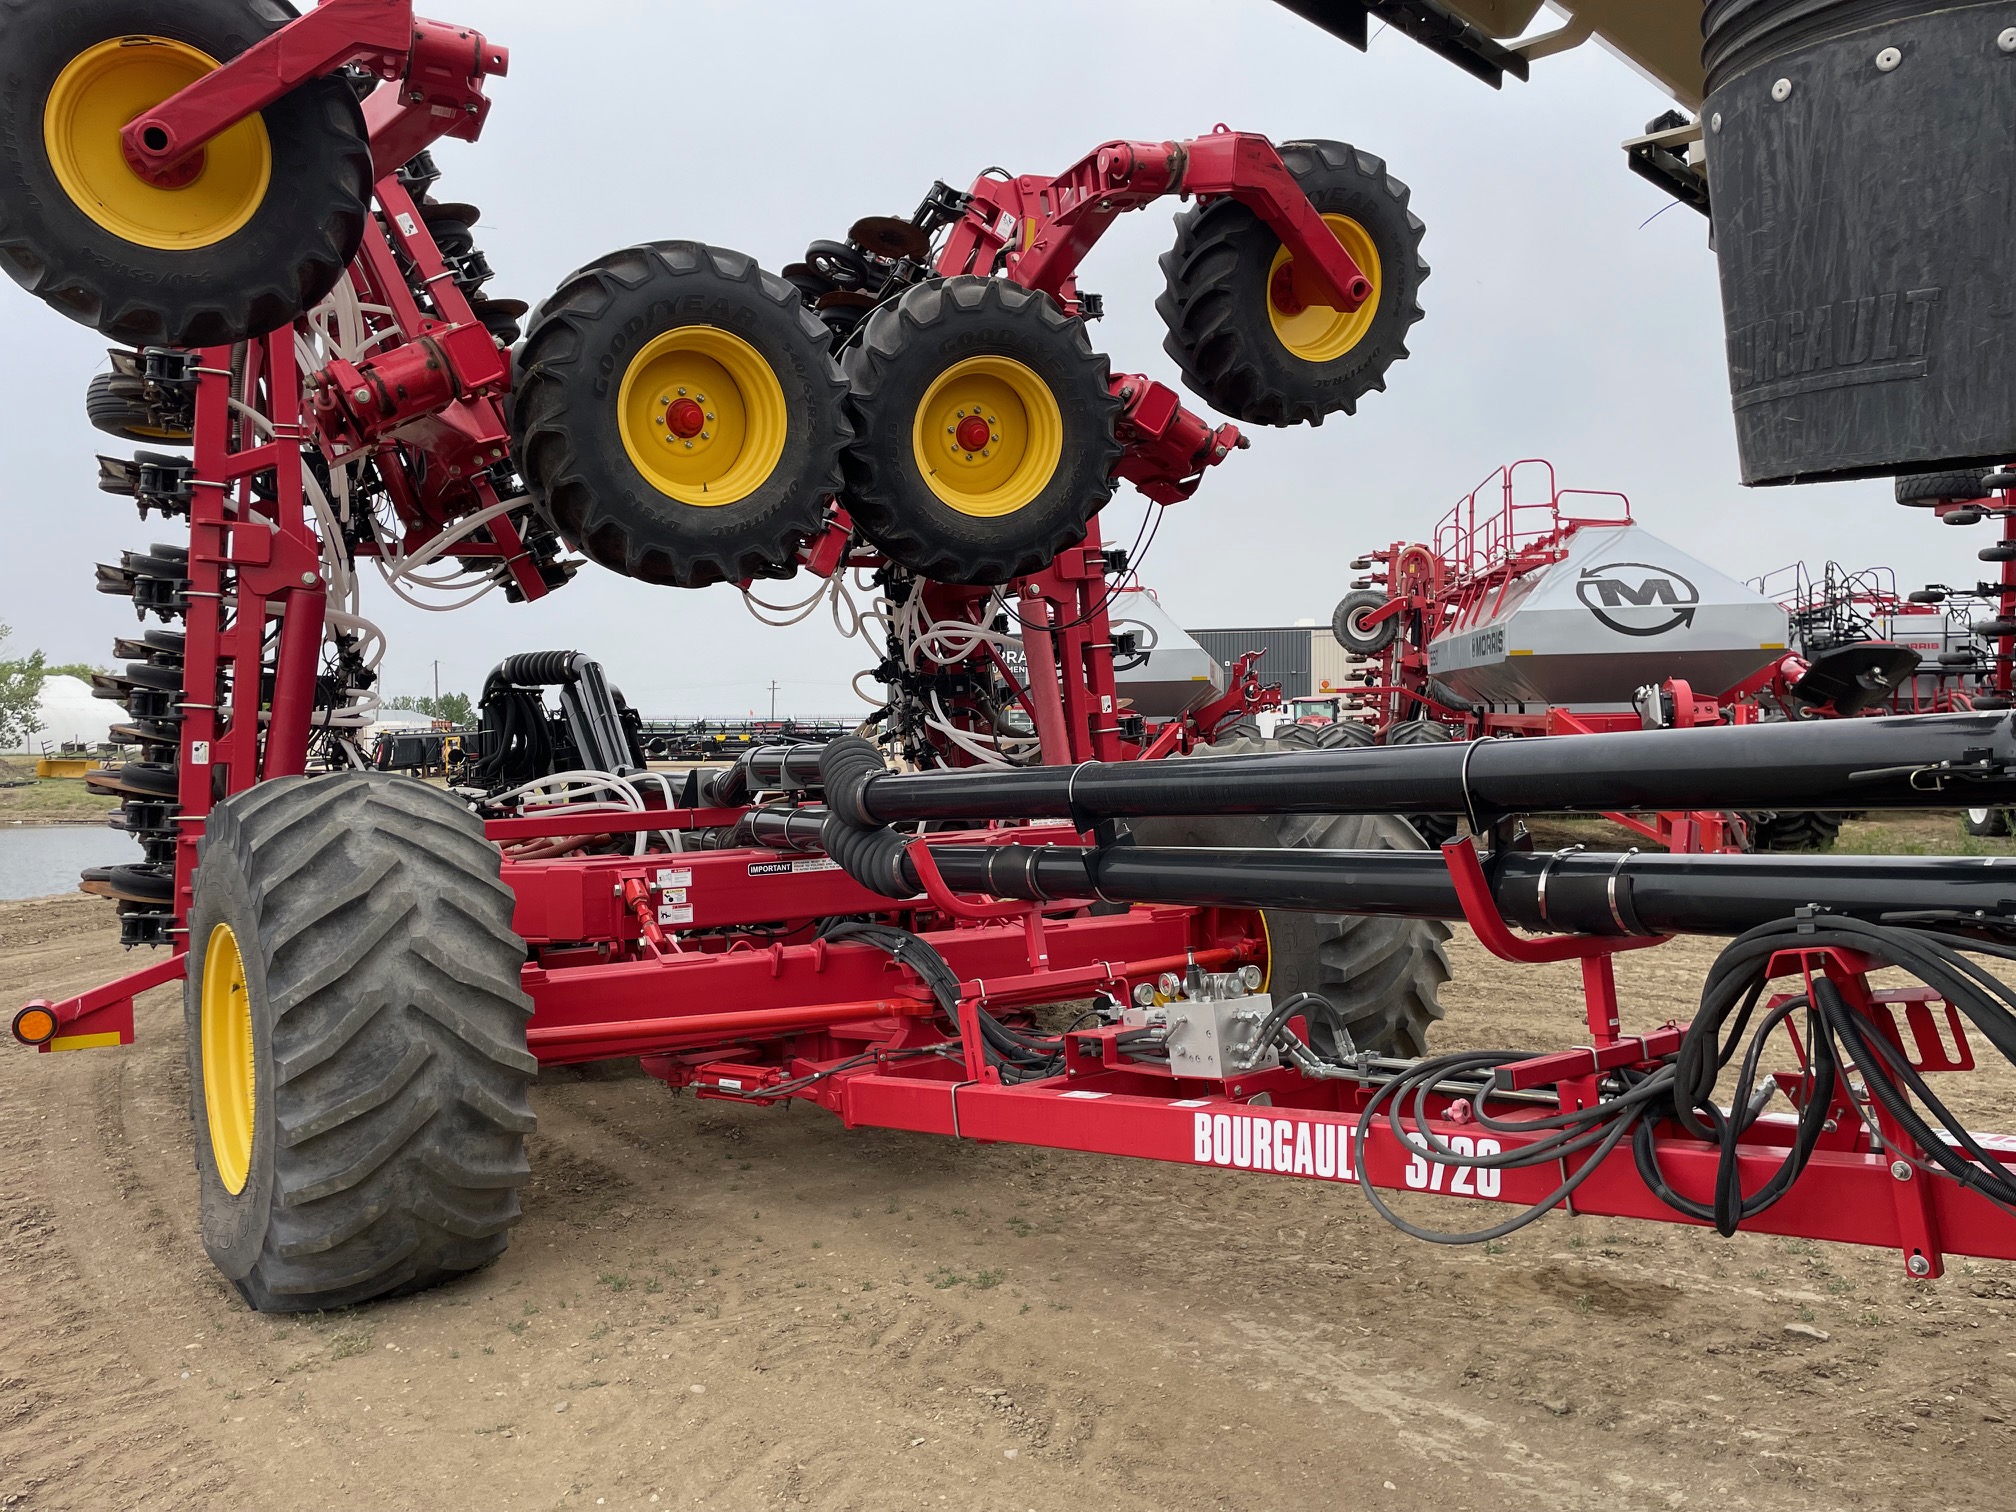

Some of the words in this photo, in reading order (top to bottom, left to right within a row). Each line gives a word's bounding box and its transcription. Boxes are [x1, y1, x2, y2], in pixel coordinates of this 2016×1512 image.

[1317, 186, 1380, 218] YEAR
[1727, 287, 1942, 391] URGAULT
[749, 862, 791, 875] IMPORTANT
[1193, 1111, 1369, 1182] BOURGAULT
[1404, 1131, 1502, 1198] 3720
